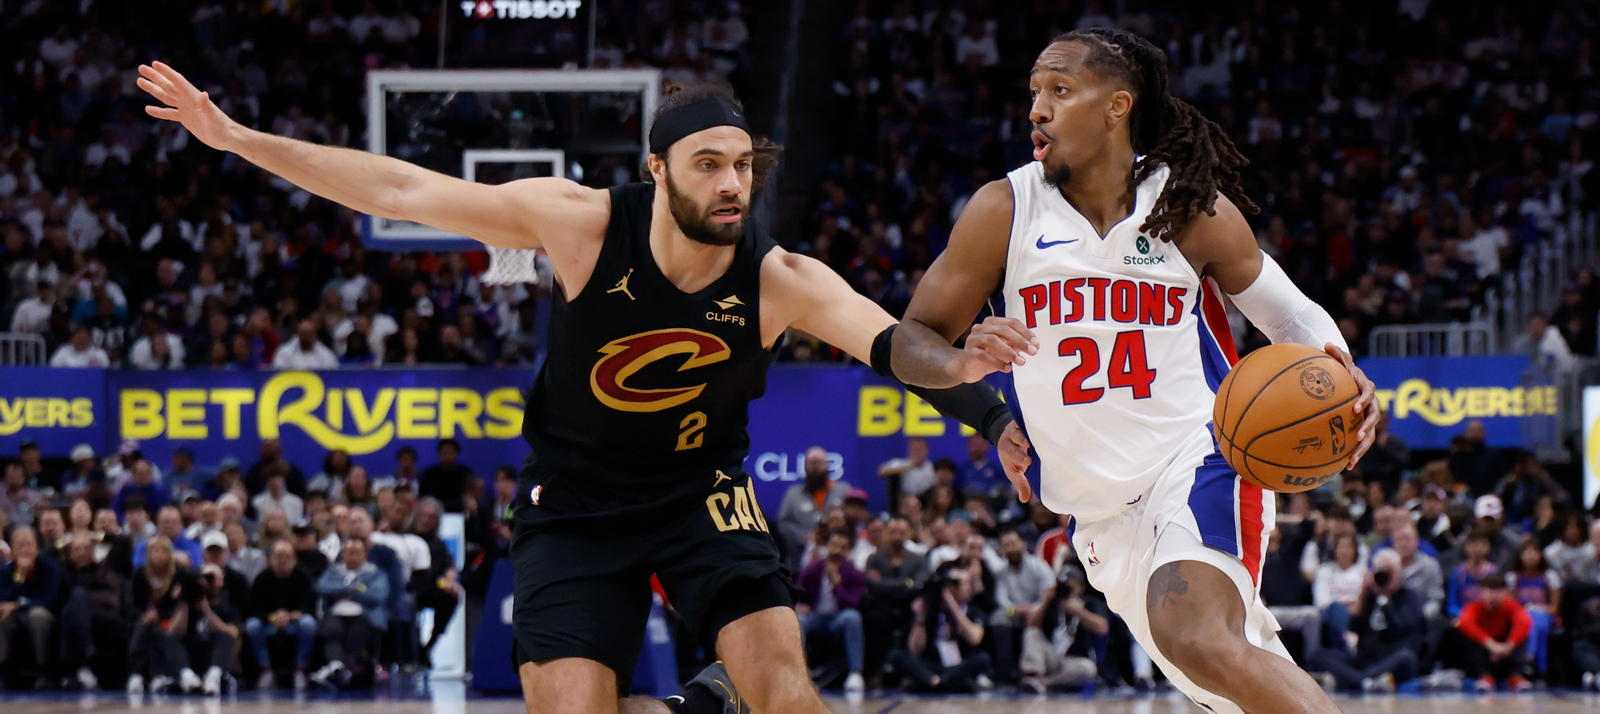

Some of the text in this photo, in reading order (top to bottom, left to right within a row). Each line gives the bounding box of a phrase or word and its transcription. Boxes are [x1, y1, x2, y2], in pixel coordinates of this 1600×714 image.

[494, 0, 581, 19] TISSOT
[1123, 255, 1166, 265] StockX
[1018, 278, 1188, 329] PISTONS
[705, 311, 745, 327] CLIFFS
[1057, 329, 1157, 406] 24
[674, 411, 707, 451] 2
[755, 452, 844, 482] CLB
